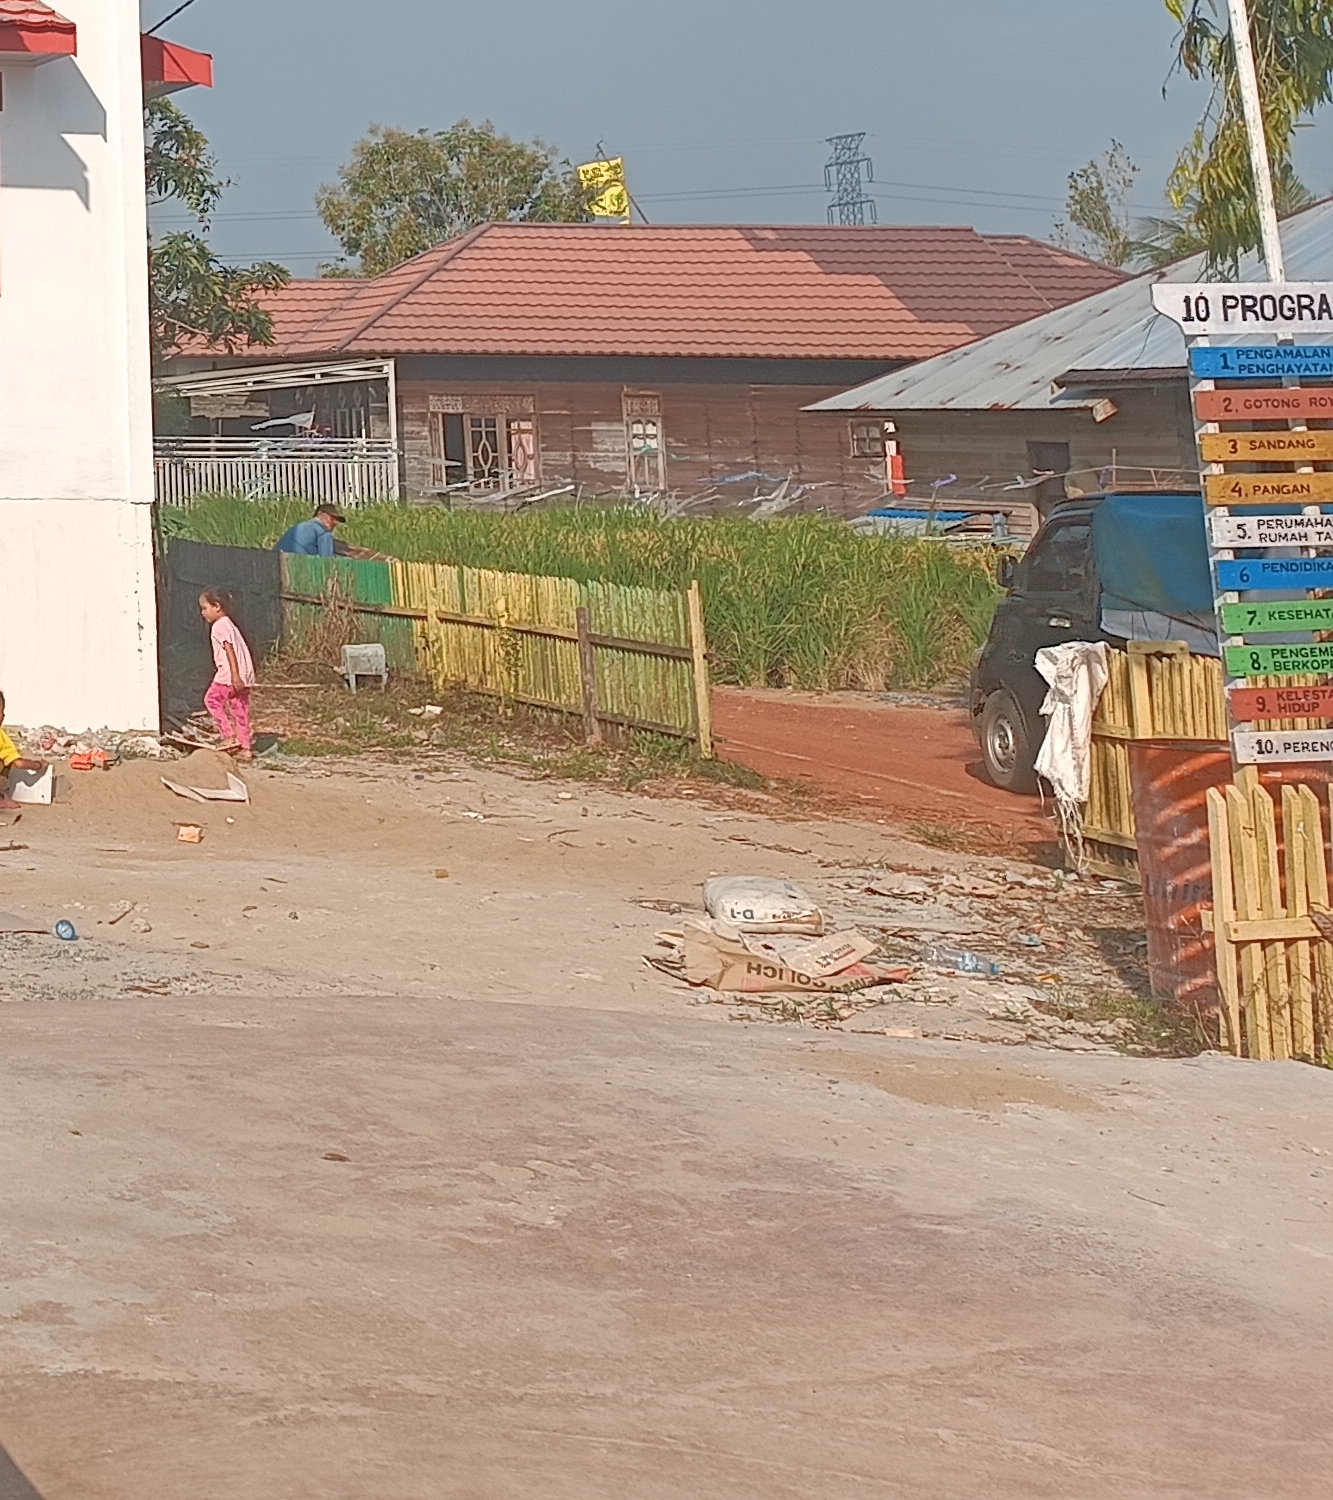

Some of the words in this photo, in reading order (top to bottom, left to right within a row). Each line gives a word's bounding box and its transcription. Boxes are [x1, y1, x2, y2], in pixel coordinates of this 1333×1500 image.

[1182, 295, 1210, 322] 10
[1219, 352, 1235, 370] 1.
[1236, 348, 1330, 360] PENGAMALAN
[1222, 397, 1239, 413] 2.
[1243, 398, 1301, 409] GOTONG
[1228, 439, 1238, 454] 3
[1249, 438, 1316, 451] SANDANG
[1230, 482, 1248, 498] 4.
[1253, 483, 1311, 495] PANGAN
[1236, 523, 1252, 540] 5.
[1258, 531, 1309, 543] RUMAH
[1239, 567, 1250, 583] 6
[1246, 610, 1262, 626] 7.
[1267, 607, 1333, 621] KESEHAT
[1250, 651, 1268, 671] 8.
[1256, 696, 1271, 713] 9.
[1278, 702, 1320, 713] HIDUP
[1255, 739, 1279, 755] 10.
